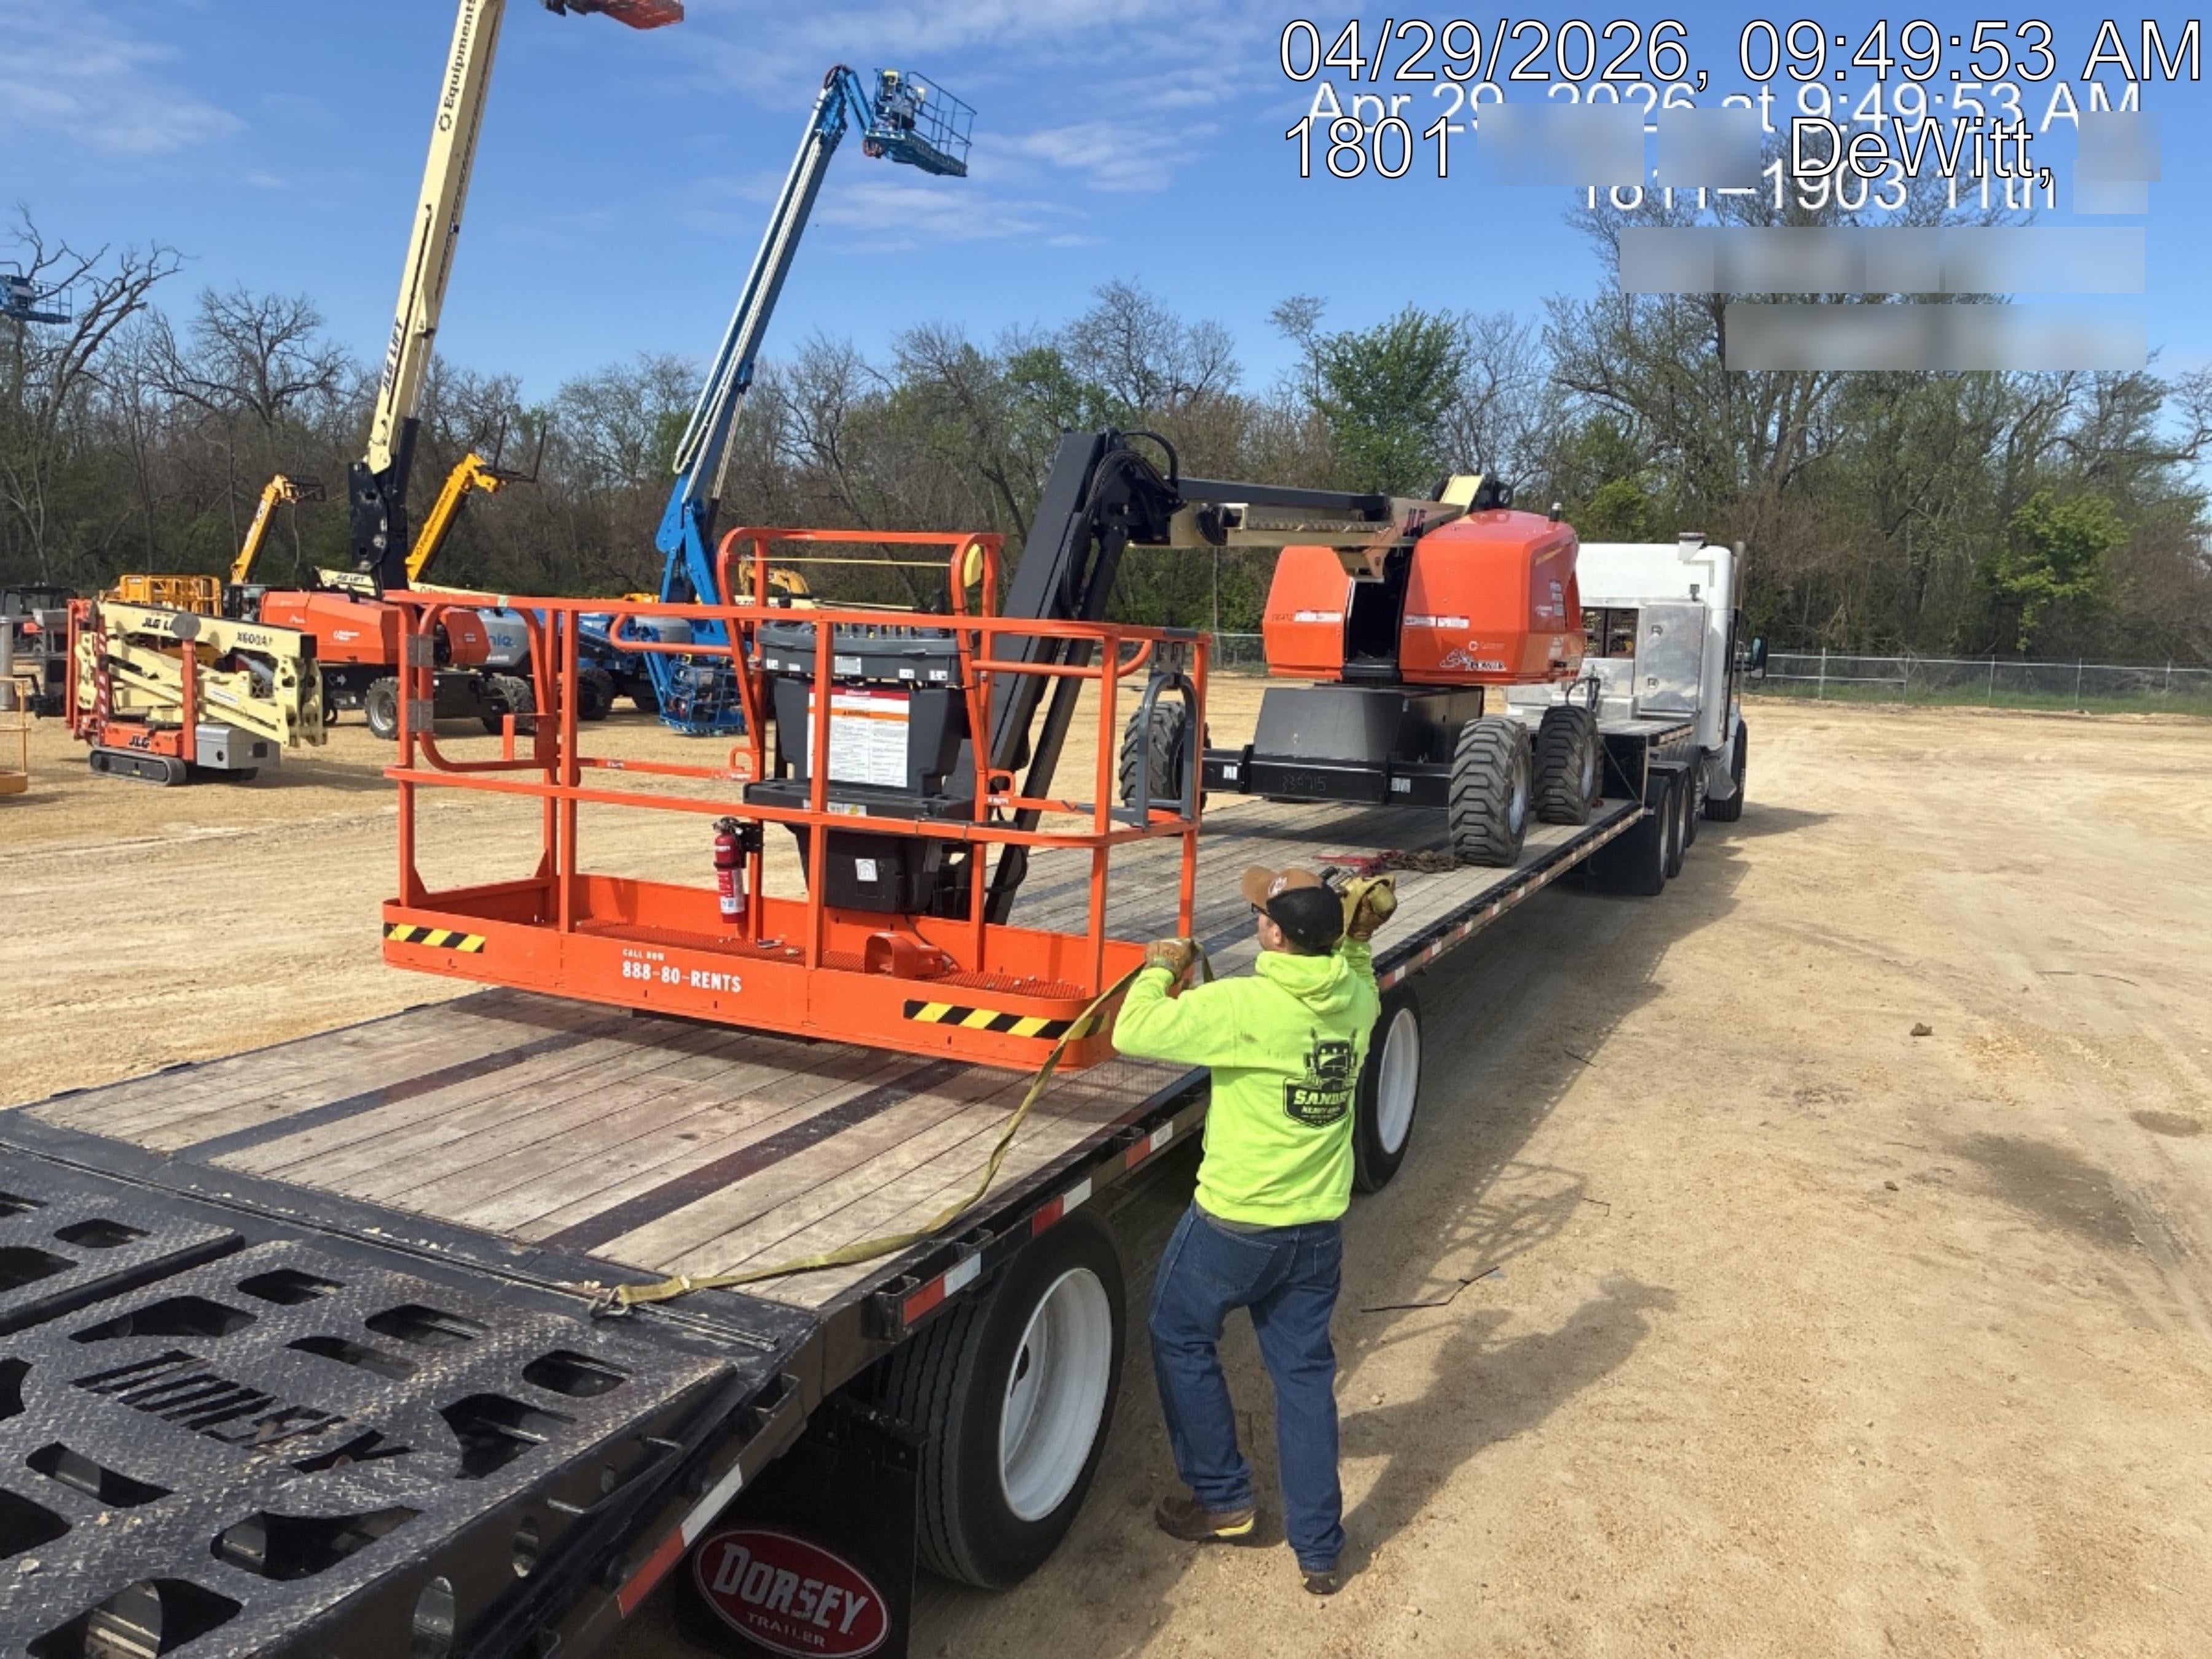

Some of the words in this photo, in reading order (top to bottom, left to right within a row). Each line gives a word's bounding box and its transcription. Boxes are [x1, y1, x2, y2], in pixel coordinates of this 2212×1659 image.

[622, 960, 742, 993] 888-80-RENTS
[712, 1541, 870, 1635] DORSEY
[747, 1610, 826, 1648] TRAILER
